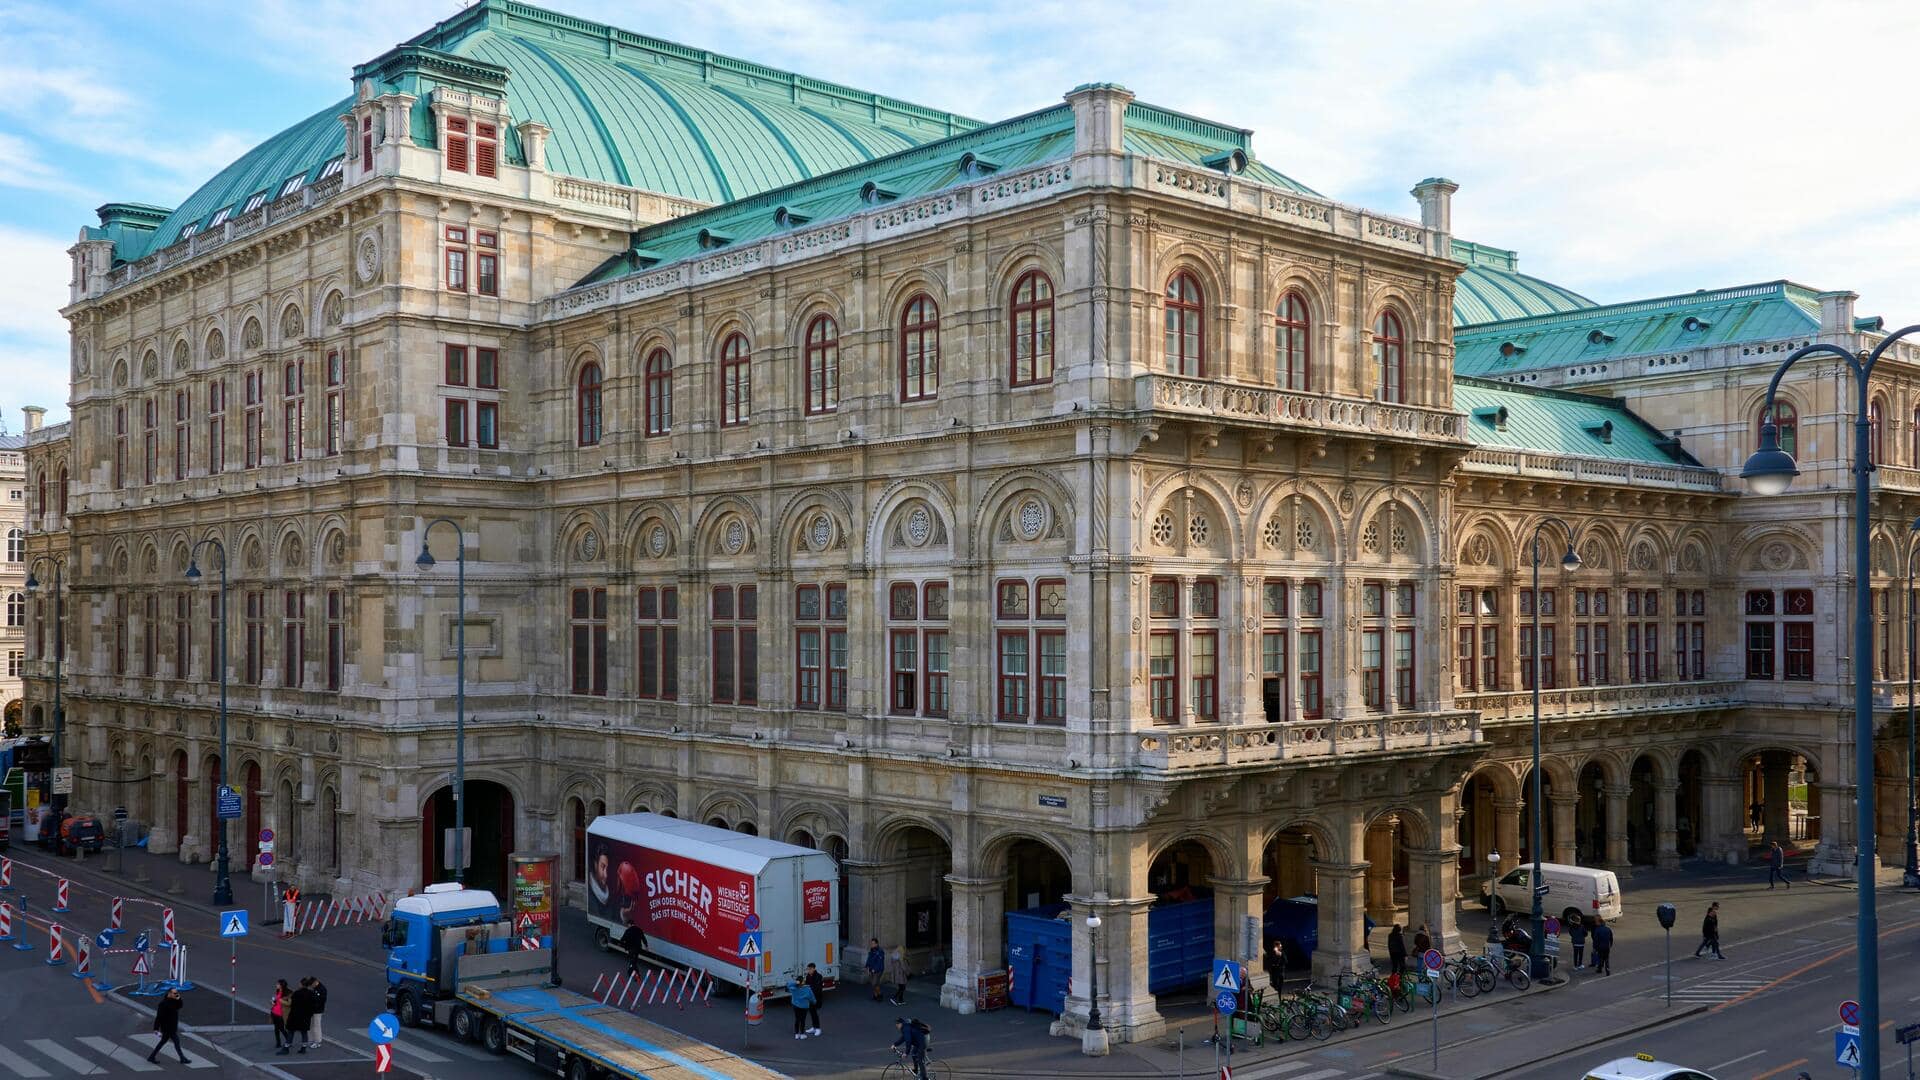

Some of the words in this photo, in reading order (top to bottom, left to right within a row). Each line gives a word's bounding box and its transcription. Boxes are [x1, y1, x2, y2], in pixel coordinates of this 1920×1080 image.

[645, 868, 713, 915] SICHER
[717, 886, 740, 900] WIENER
[649, 897, 662, 910] SEIN
[661, 896, 676, 906] ODER
[676, 898, 694, 914] NICHT
[651, 910, 662, 921] DAS
[662, 909, 670, 918] IST
[670, 908, 687, 922] KEINE
